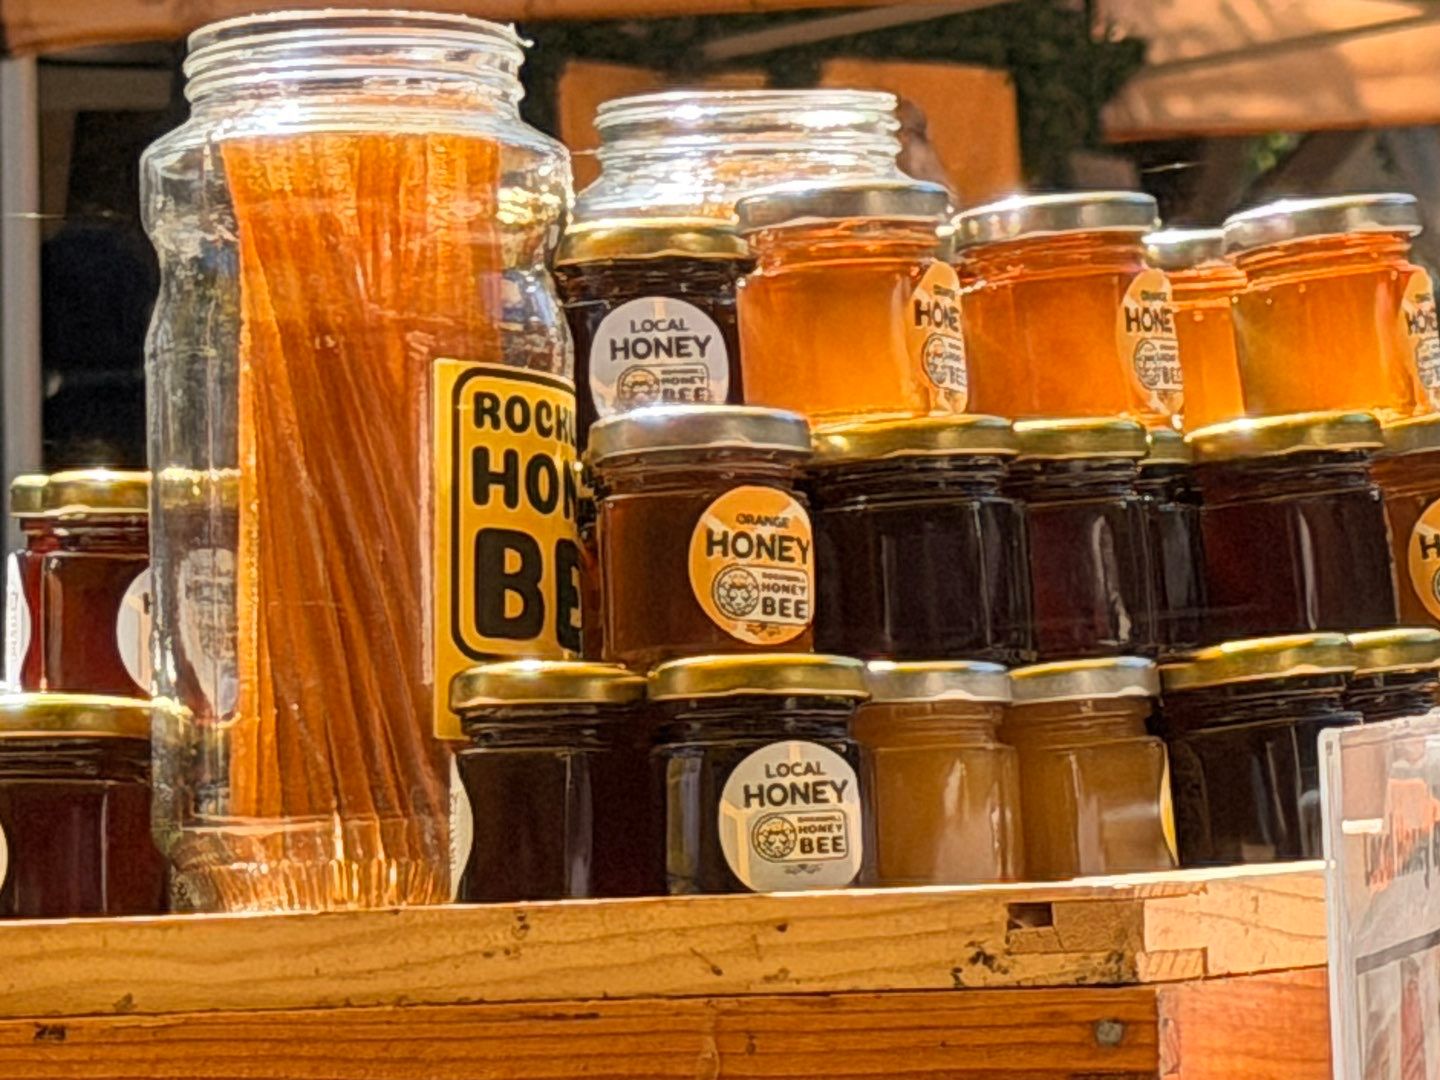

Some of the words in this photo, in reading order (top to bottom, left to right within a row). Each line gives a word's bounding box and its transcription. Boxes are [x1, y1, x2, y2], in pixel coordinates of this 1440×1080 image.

[629, 318, 690, 334] LOCAL
[1125, 305, 1174, 333] HONE
[609, 334, 712, 361] HONEY
[735, 512, 791, 529] ORANGE
[705, 528, 811, 565] HONEY
[760, 582, 807, 596] HONEY
[761, 596, 808, 620] BEE
[764, 761, 827, 779] LOCAL
[742, 779, 849, 809] HONEY
[797, 823, 844, 835] HONEY
[799, 836, 847, 855] BEE
